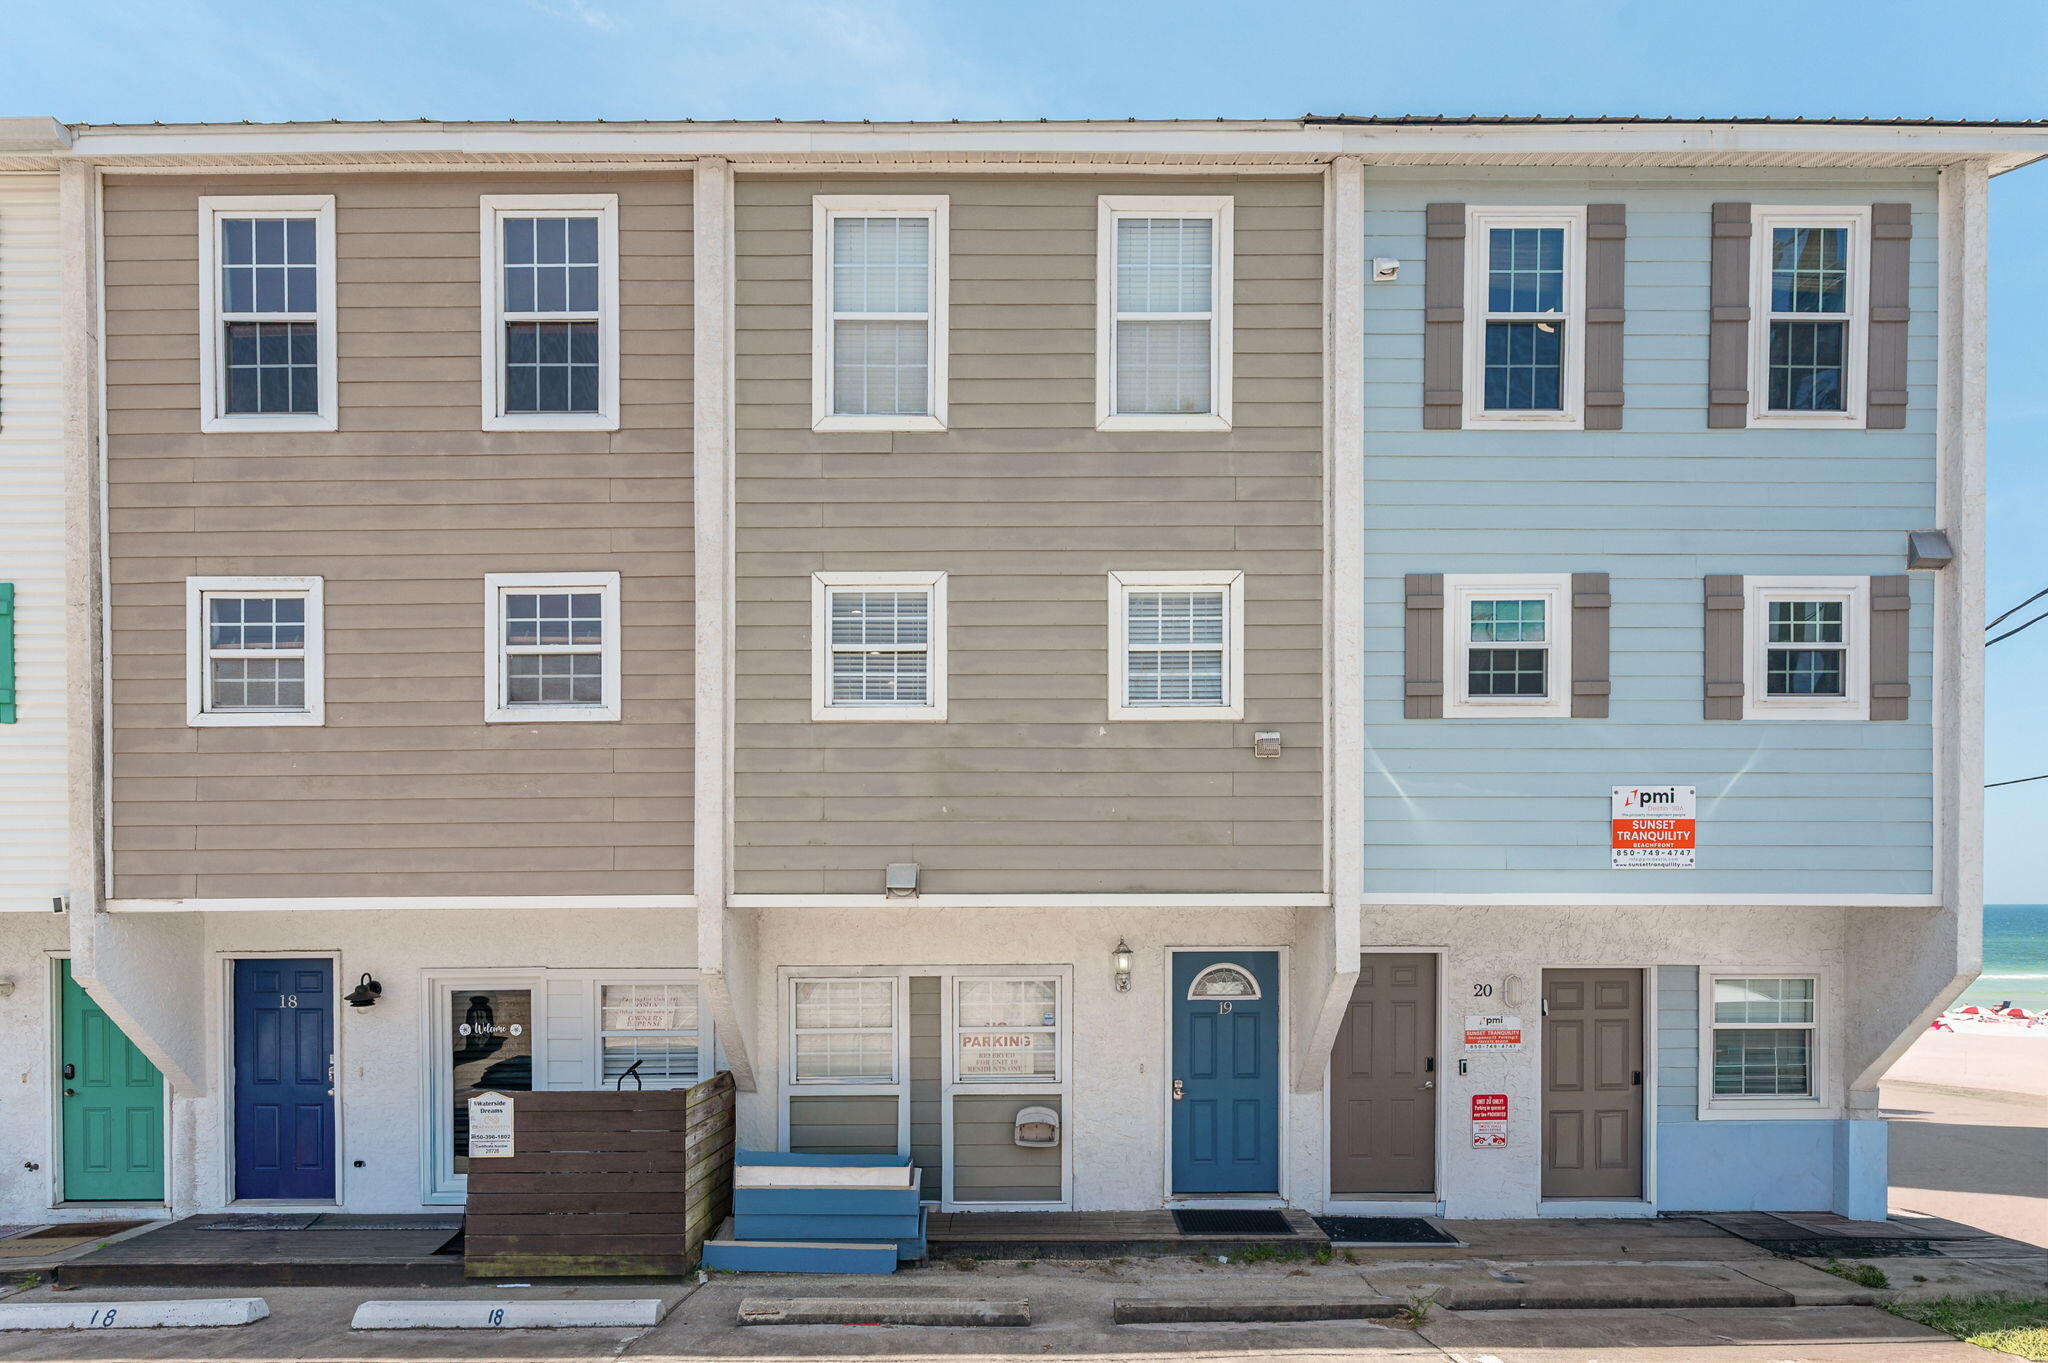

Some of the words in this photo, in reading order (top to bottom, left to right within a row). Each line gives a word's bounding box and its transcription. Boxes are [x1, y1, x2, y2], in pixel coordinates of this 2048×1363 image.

[1640, 788, 1675, 807] pmi
[1632, 820, 1675, 829] SUNSET
[1617, 831, 1690, 841] TRANQUILITY
[1473, 983, 1493, 997] 20
[279, 994, 298, 1008] 18
[1217, 1001, 1233, 1015] 19
[1486, 1016, 1503, 1025] pmi
[474, 1022, 506, 1035] Welcome
[962, 1036, 1031, 1047] PARKING
[90, 1308, 117, 1327] 18
[488, 1308, 504, 1327] 18
